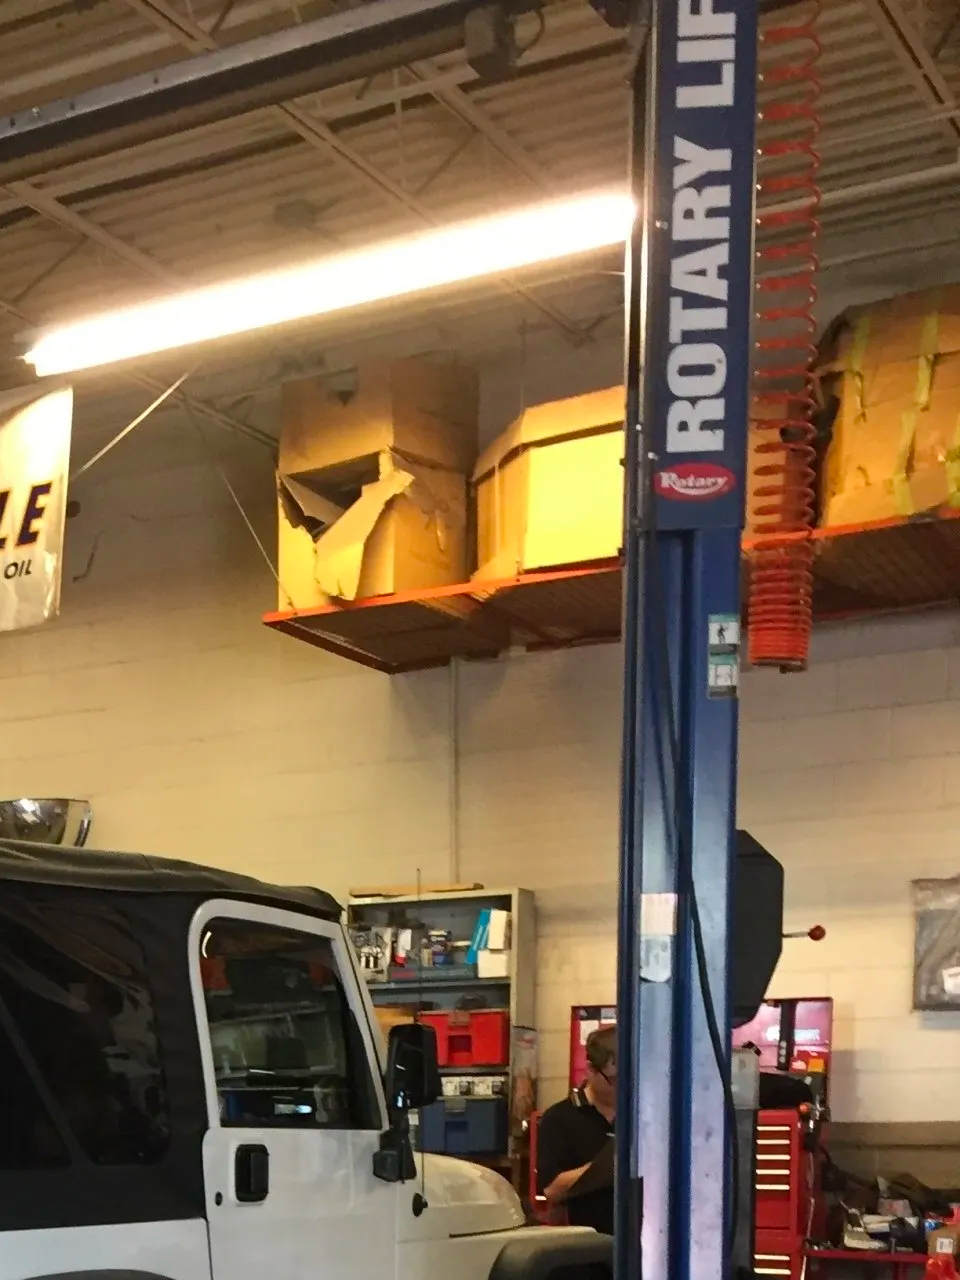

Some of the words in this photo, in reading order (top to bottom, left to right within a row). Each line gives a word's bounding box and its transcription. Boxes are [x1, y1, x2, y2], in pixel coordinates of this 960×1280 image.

[666, 135, 732, 453] ROTARY
[660, 471, 728, 496] Rotary
[3, 559, 32, 580] OIL
